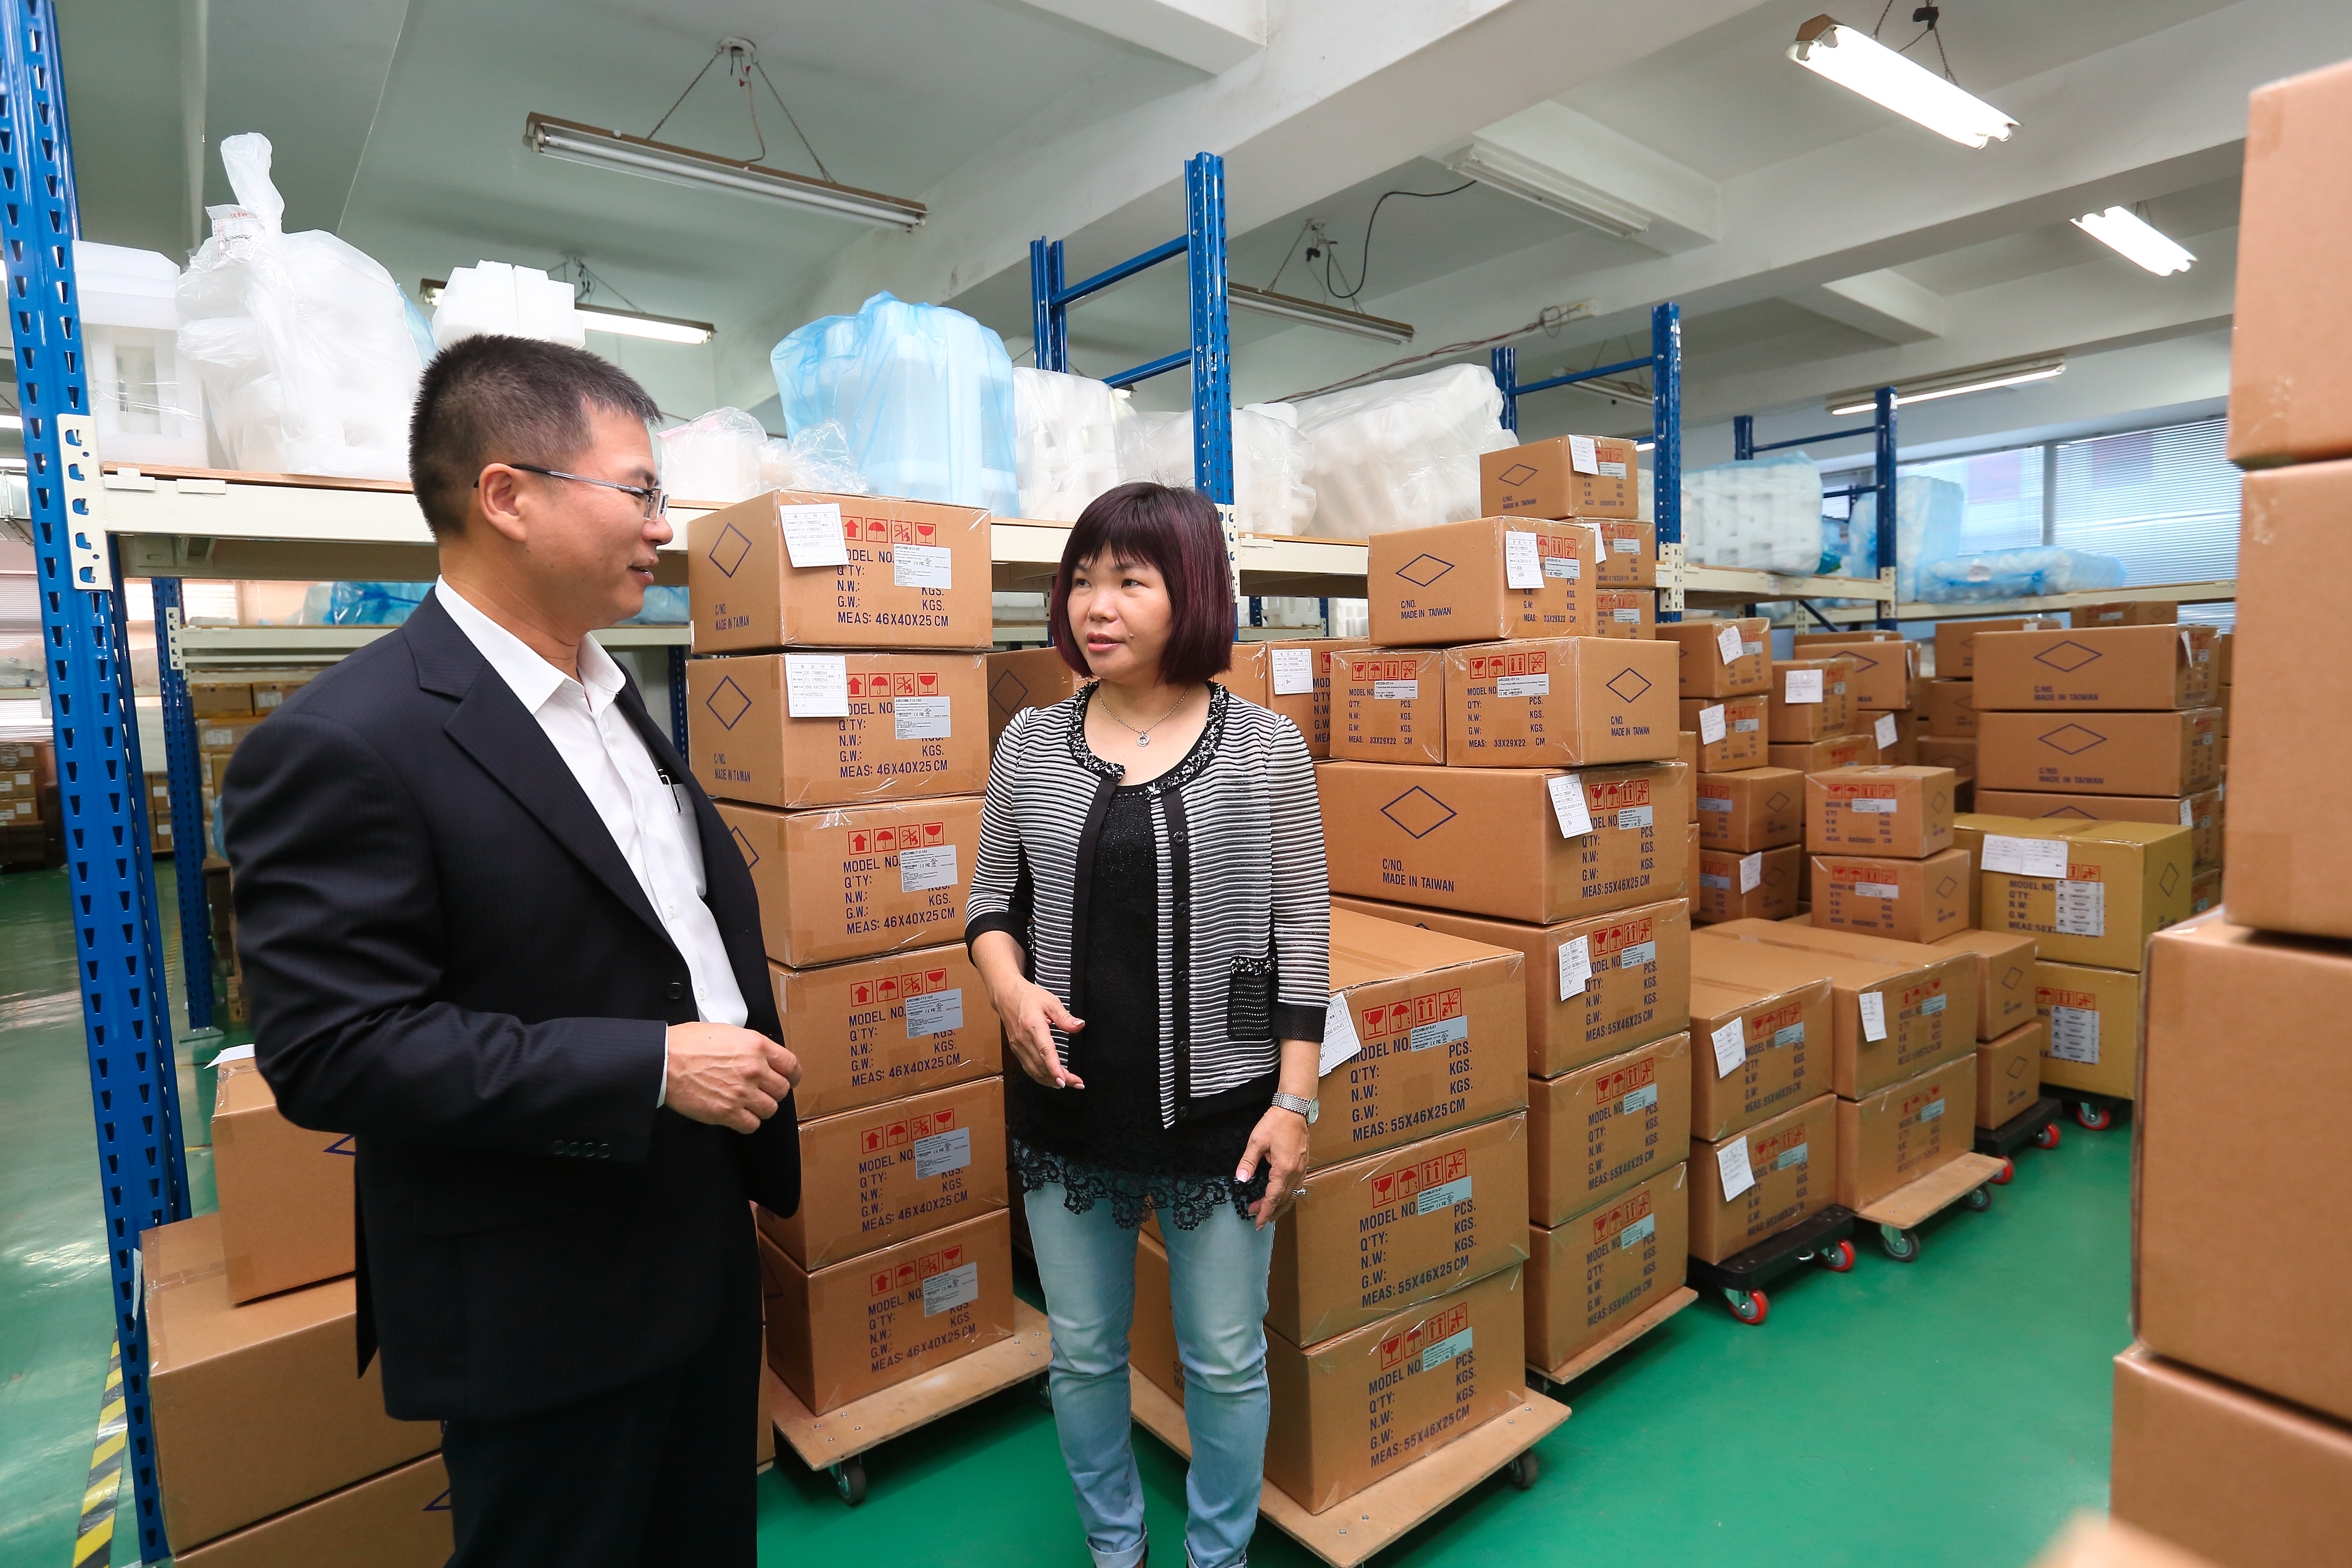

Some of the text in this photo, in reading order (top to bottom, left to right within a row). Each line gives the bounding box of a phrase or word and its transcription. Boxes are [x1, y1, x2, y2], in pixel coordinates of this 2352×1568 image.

[846, 549, 873, 561] ODEL
[879, 551, 894, 563] NO.
[837, 580, 859, 592] N.W.:
[1566, 589, 1576, 598] KGS.
[715, 604, 726, 615] C/NO.
[838, 596, 944, 610] G.W.: KGS.
[1401, 600, 1416, 608] C/NO.
[1566, 602, 1576, 611] KGS.
[838, 612, 949, 627] MEAS: 46X40X25 CM
[1401, 610, 1417, 619] MADE
[1428, 607, 1451, 617] TAIWAN
[1523, 613, 1537, 622] MEAS:
[1570, 615, 1576, 624] CM
[716, 615, 749, 630] MADE IN TAIWAN
[1468, 687, 1487, 695] MODEL
[849, 703, 874, 716] ODEL
[880, 702, 892, 714] NO.
[1468, 697, 1543, 709] Q'TY: PCS.
[838, 719, 866, 731] Q'TY:
[1530, 724, 1544, 732] KGS.
[1611, 716, 1623, 725] C/NO.
[1611, 728, 1624, 736] MADE
[1633, 726, 1649, 735] TAIWAN
[840, 735, 861, 746] N.W.:
[714, 753, 726, 764] C/NO.
[840, 745, 944, 762] G.W.: KGS.
[715, 768, 750, 782] MADE IN TAIWAN
[841, 760, 948, 777] MEAS: 46X40X25 CM
[1608, 815, 1619, 827] NO.
[1582, 826, 1655, 848] Q'TY: PCS.
[1583, 841, 1655, 863] N.W: KGS.
[844, 858, 880, 873] MODEL
[885, 855, 900, 868] NO.
[1383, 859, 1403, 871] C/NO.
[1583, 858, 1655, 881] G.W: KGS.
[845, 875, 871, 888] Q'TY:
[1383, 873, 1454, 892] MADE IN TAIWAN
[1582, 874, 1649, 898] MEAS: 55X46X25 CM
[846, 891, 867, 904] N.W.:
[846, 893, 951, 919] G.W.: KGS.
[847, 907, 954, 934] MEAS: 46X40X25 CM
[849, 1006, 906, 1027] MODEL NO.
[850, 1027, 877, 1042] Q'TY:
[851, 1043, 872, 1056] N.W.:
[852, 1040, 956, 1071] G.W.: KGS.
[1350, 1037, 1411, 1064] MODEL NO.
[1351, 1041, 1471, 1083] Q'TY: PCS.
[852, 1053, 960, 1087] MEAS: 46X40X25 CM
[1352, 1059, 1472, 1102] N.W: KGS.
[1352, 1078, 1472, 1122] G.W: KGS.
[1353, 1098, 1465, 1142] MEAS: 55X46X25 CM
[1360, 1201, 1418, 1232] MODEL NO.
[1361, 1199, 1476, 1252] Q'TY: PCS.
[1361, 1217, 1476, 1270] N.W: KGS.
[1362, 1235, 1476, 1289] G.W: KGS.
[1362, 1255, 1468, 1307] MEAS: 55X46X25 CM
